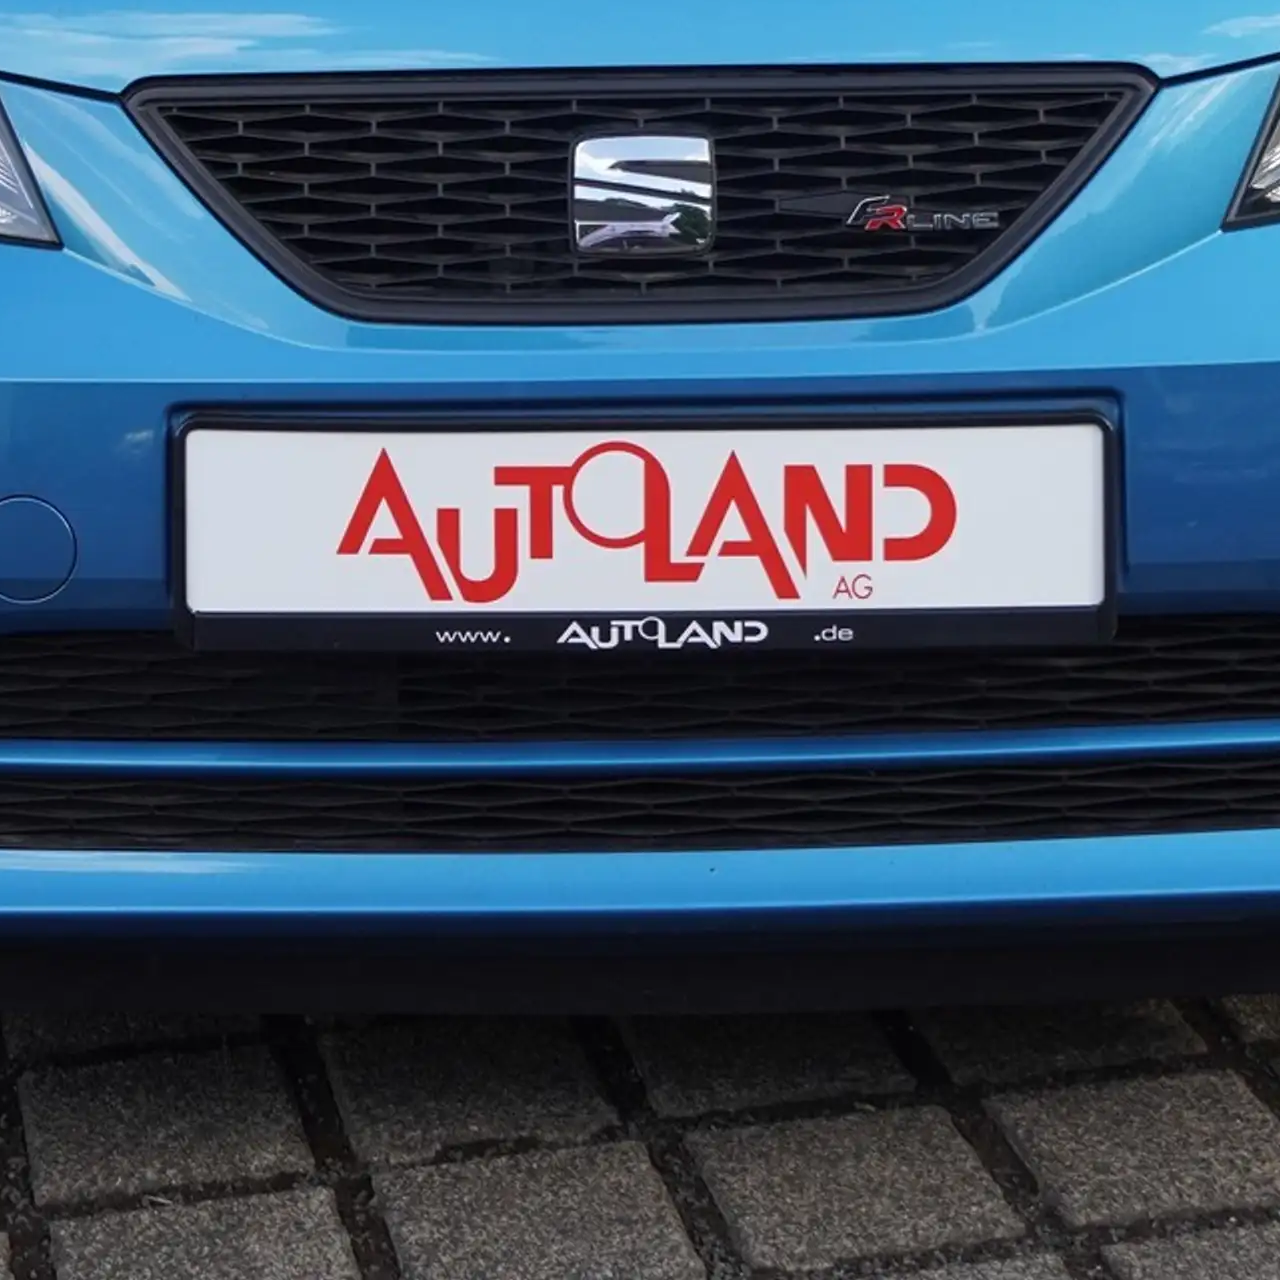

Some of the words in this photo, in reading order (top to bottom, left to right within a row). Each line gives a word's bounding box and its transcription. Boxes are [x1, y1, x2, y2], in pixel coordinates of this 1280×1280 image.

[336, 440, 958, 604] AUTOLAND
[832, 574, 874, 600] AG
[435, 629, 512, 644] www.
[556, 616, 769, 650] AUTOLAND
[813, 624, 855, 642] .de
